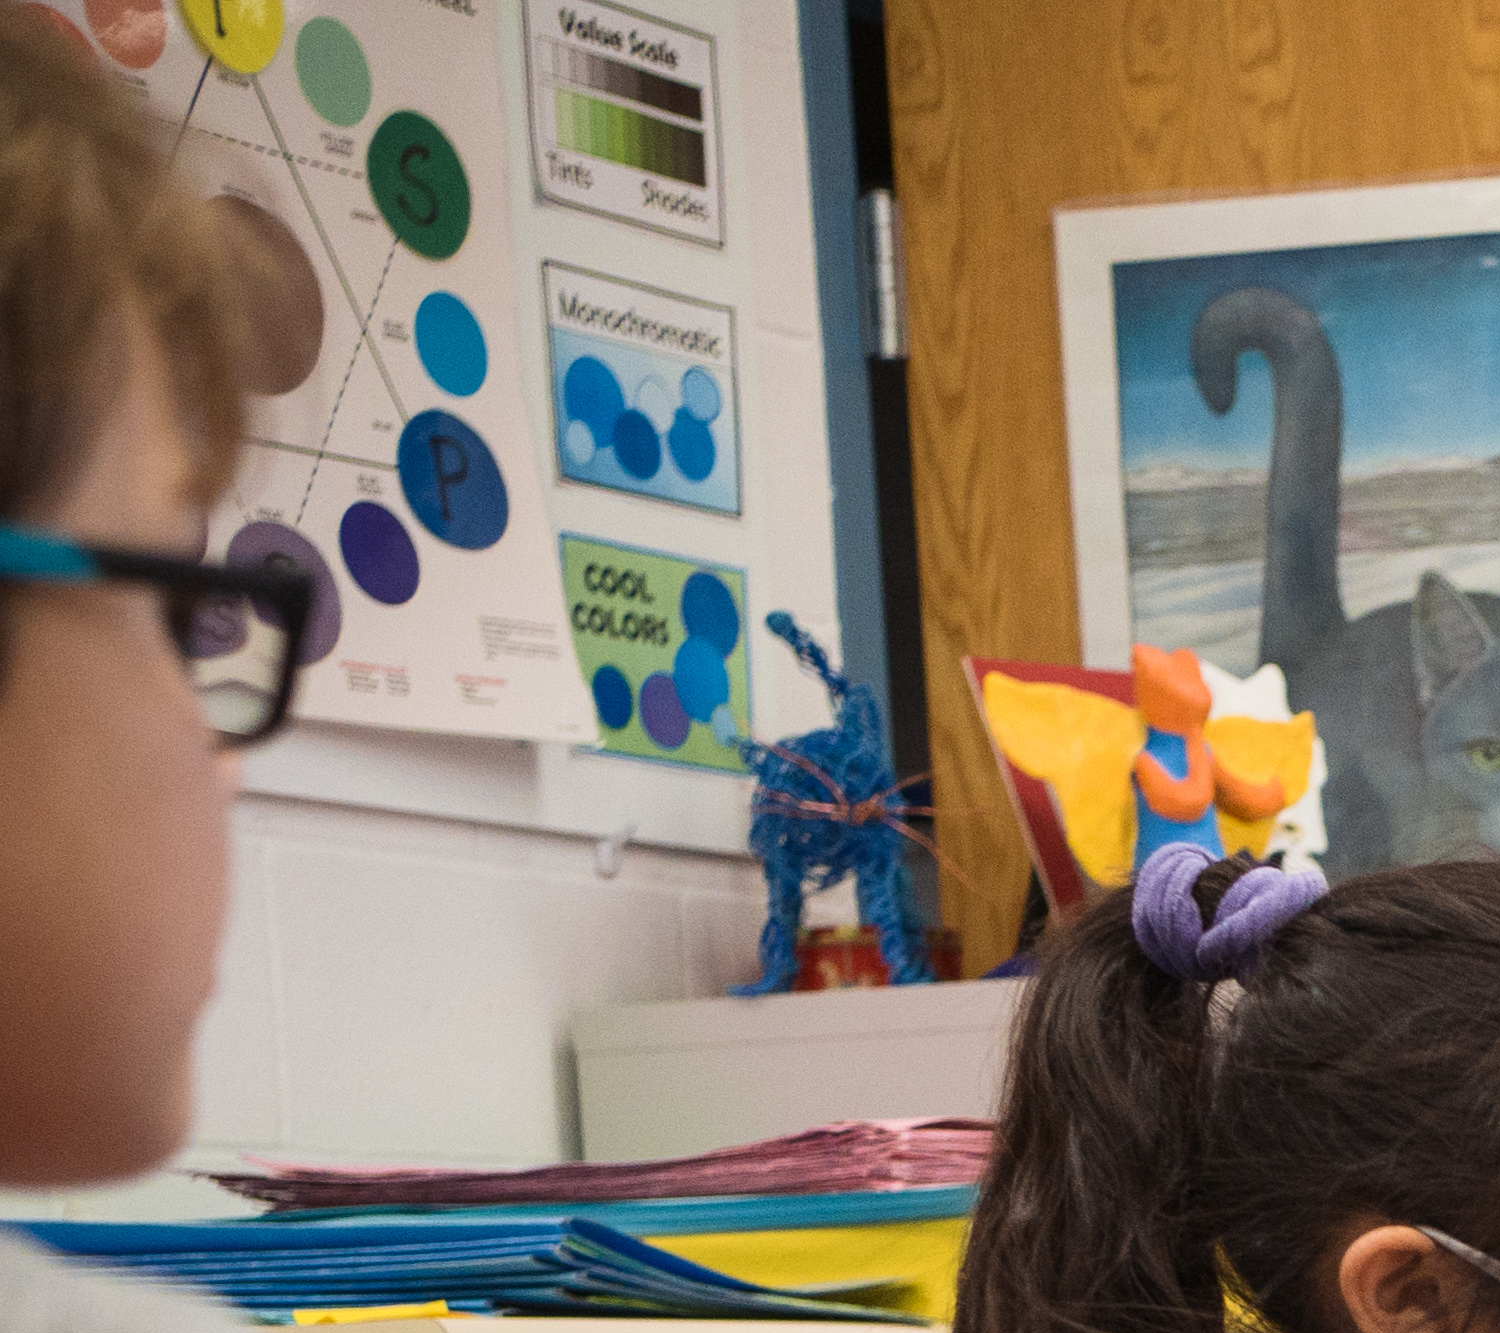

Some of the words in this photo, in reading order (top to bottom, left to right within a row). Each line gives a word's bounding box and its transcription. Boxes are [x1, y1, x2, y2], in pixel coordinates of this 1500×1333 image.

[397, 143, 439, 227] S
[428, 433, 470, 524] P
[583, 561, 655, 604] COOL
[570, 601, 669, 647] COLORS
